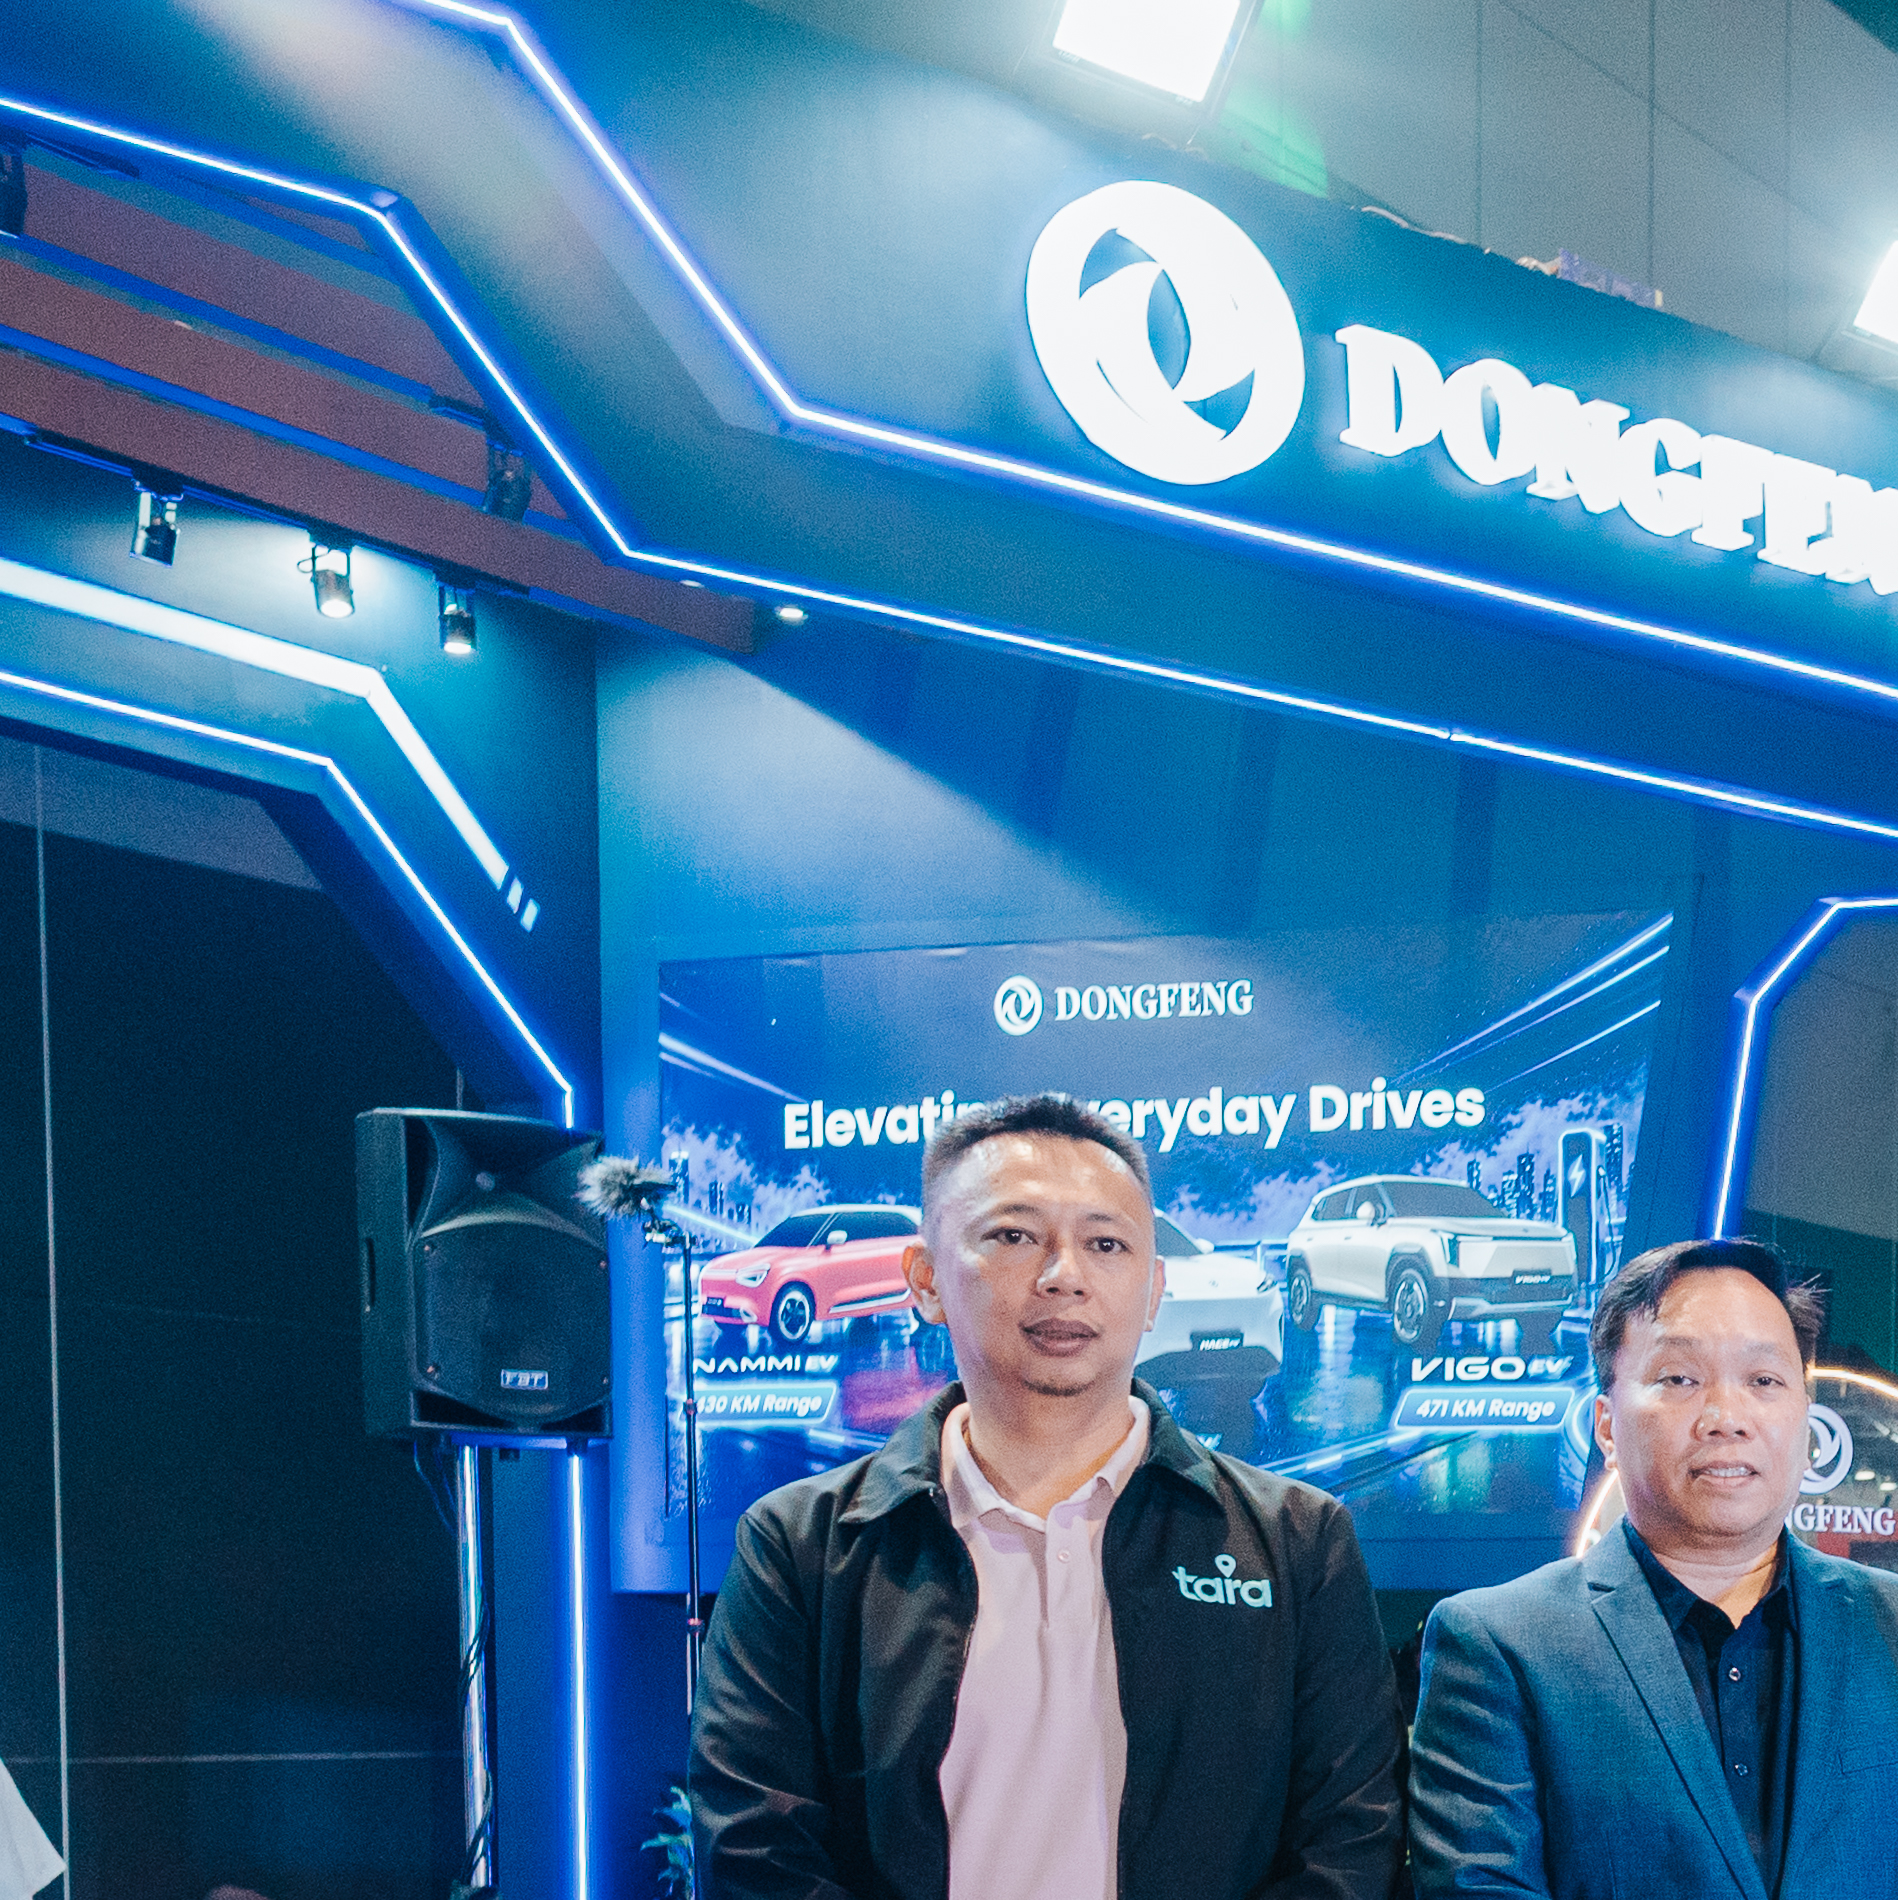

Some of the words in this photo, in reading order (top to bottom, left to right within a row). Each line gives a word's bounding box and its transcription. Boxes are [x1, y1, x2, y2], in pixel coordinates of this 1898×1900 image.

[1054, 980, 1254, 1021] DONGFENG
[784, 1089, 984, 1150] Elevati
[1087, 1086, 1297, 1153] eryday
[1309, 1076, 1486, 1133] Drives
[693, 1355, 800, 1374] NAMMI
[805, 1355, 838, 1372] EV
[1411, 1356, 1526, 1381] VIGO
[1532, 1357, 1565, 1374] EV
[730, 1395, 759, 1413] KM
[763, 1394, 822, 1417] Range
[1416, 1399, 1449, 1417] 471
[1452, 1399, 1485, 1416] KM
[1488, 1399, 1556, 1422] Range
[1784, 1503, 1896, 1535] GFENG
[1172, 1565, 1273, 1608] tara
